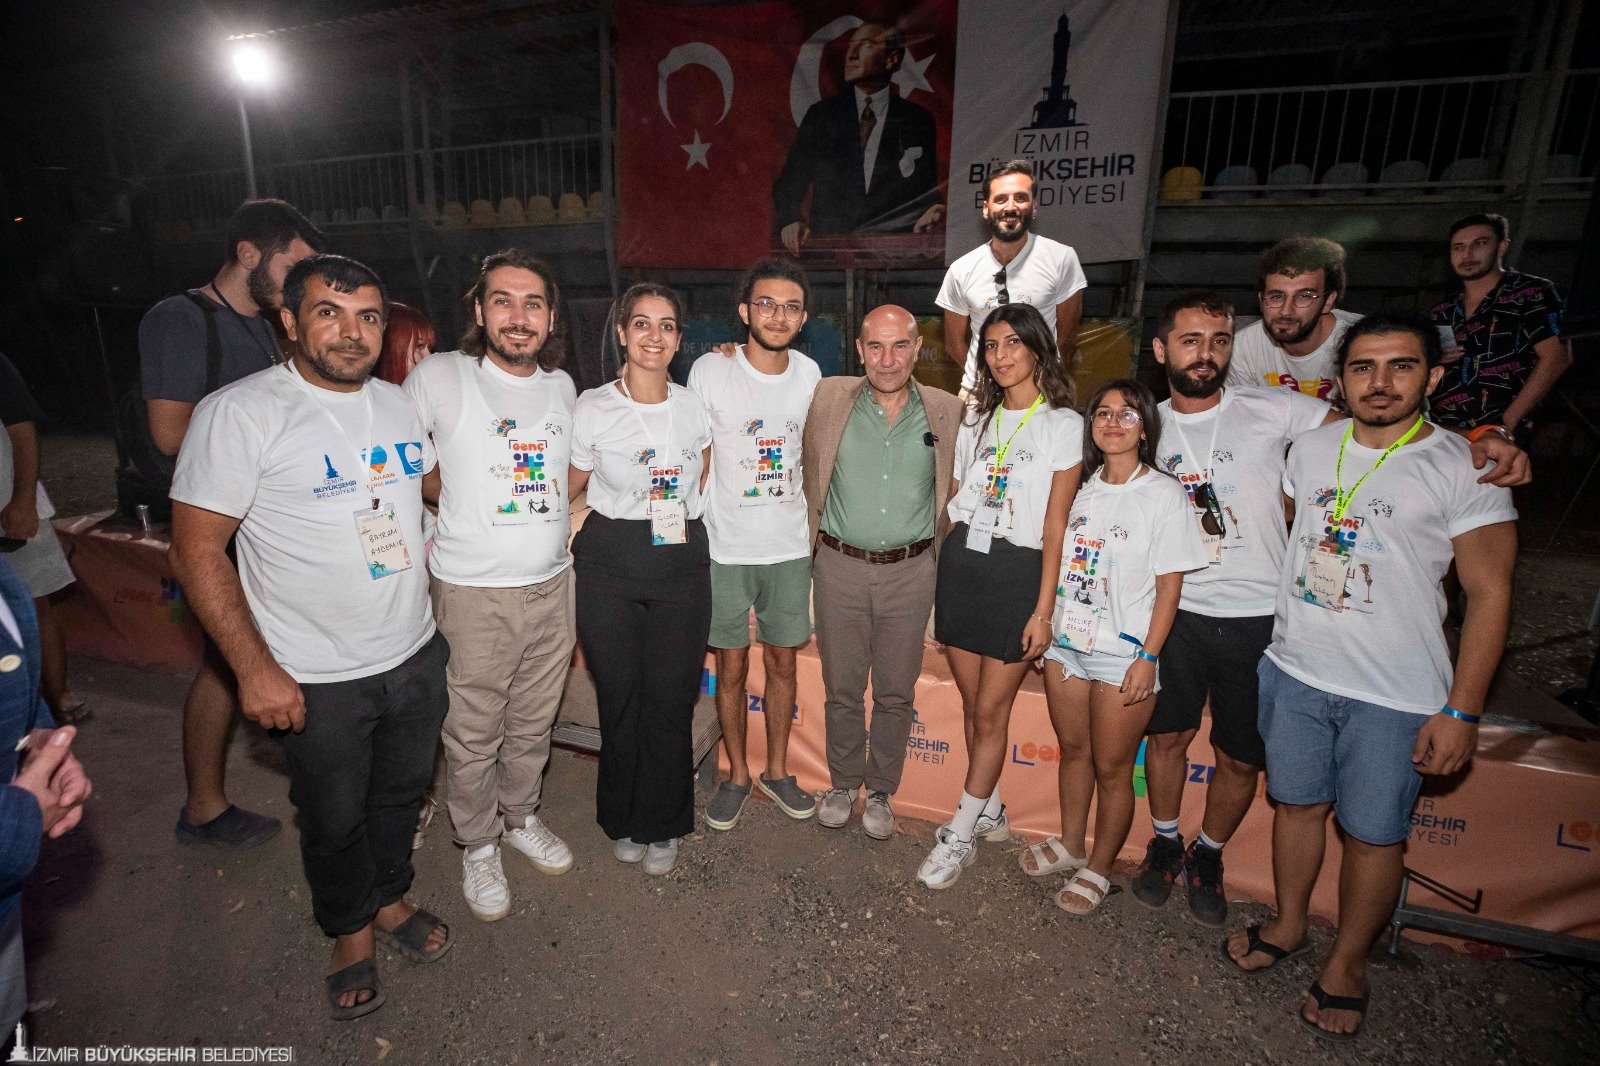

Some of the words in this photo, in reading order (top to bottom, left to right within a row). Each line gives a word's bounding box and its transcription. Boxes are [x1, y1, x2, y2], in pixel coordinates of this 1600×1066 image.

[1013, 129, 1090, 154] İZMİR
[514, 481, 547, 493] İZMİR
[1066, 570, 1095, 587] İZMR
